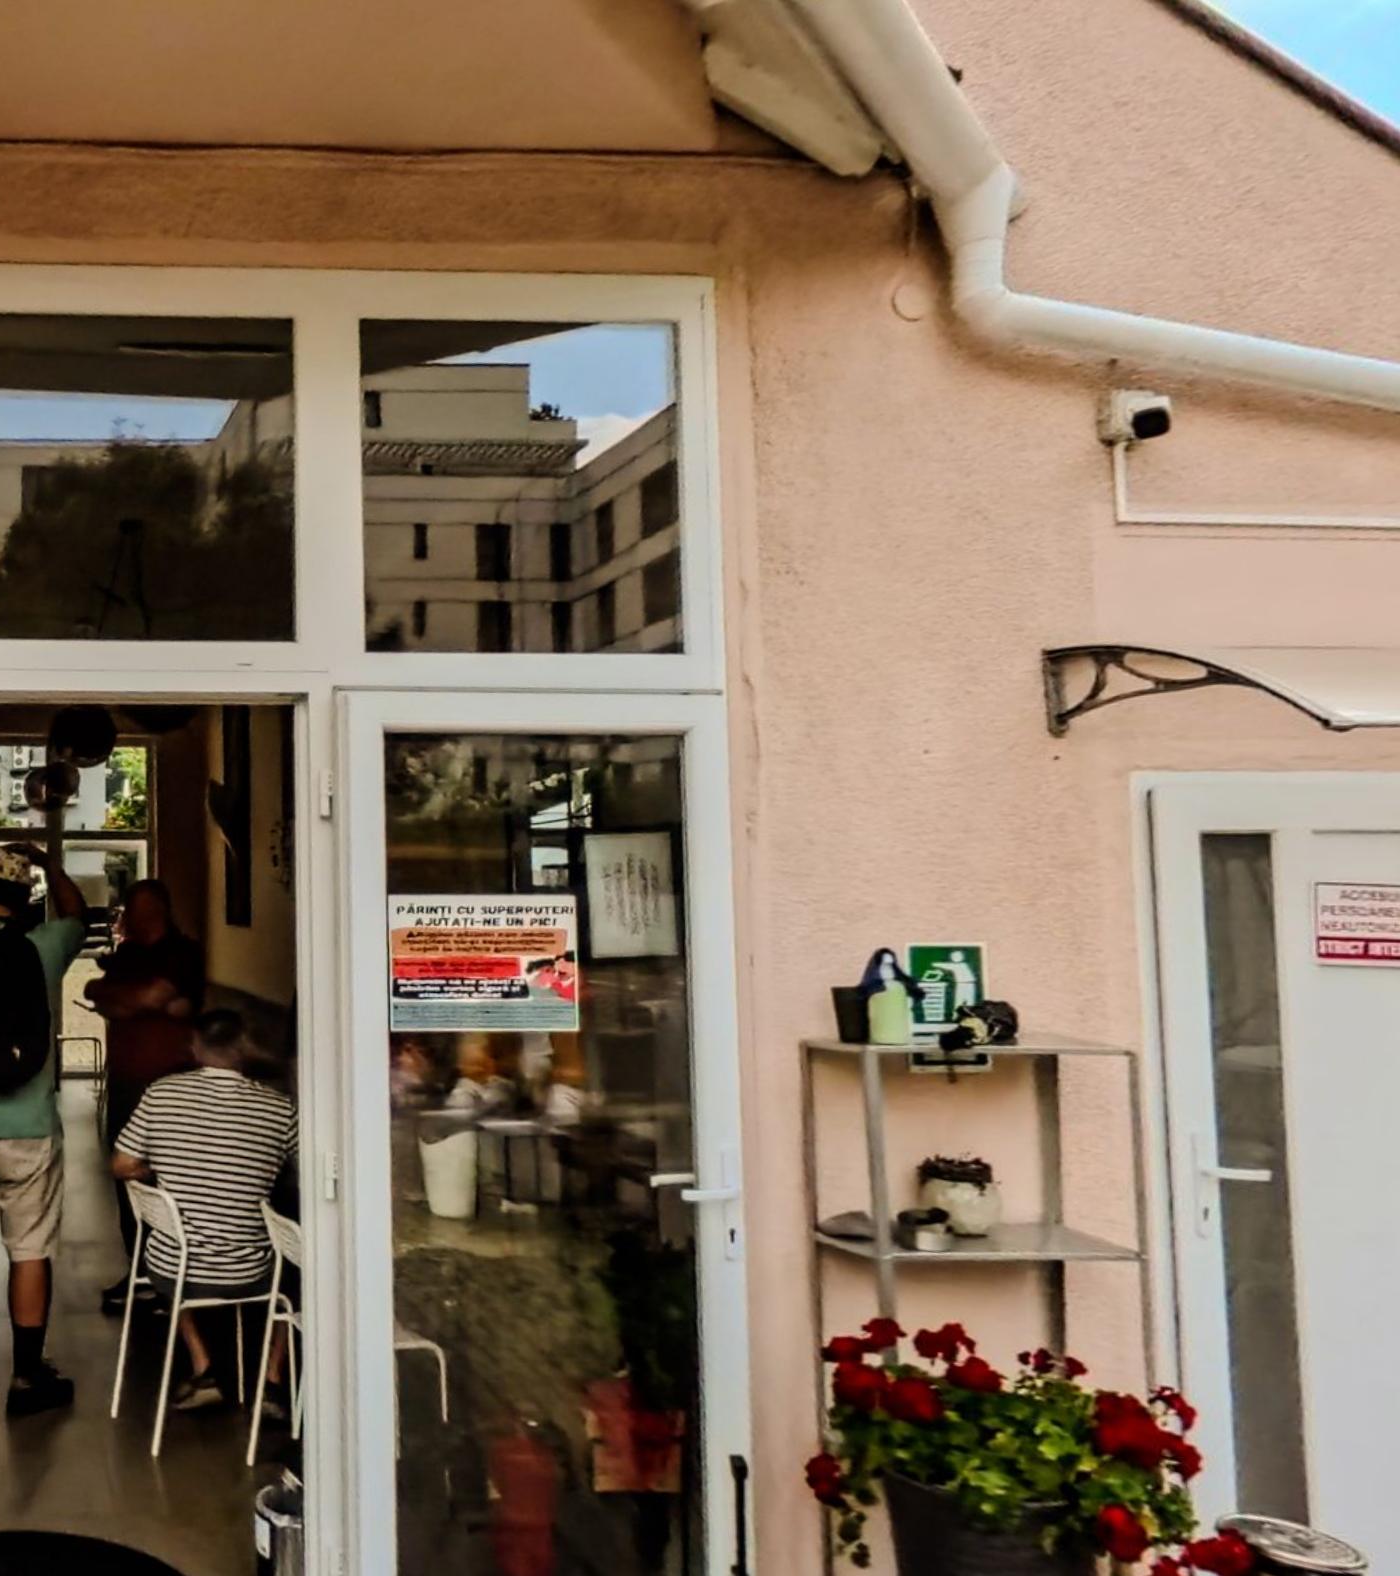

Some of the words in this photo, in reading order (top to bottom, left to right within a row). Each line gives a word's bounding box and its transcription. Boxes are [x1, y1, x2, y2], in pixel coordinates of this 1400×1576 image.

[457, 905, 474, 915] CU
[479, 905, 574, 915] SUPERPUTERI
[506, 918, 523, 927] UN
